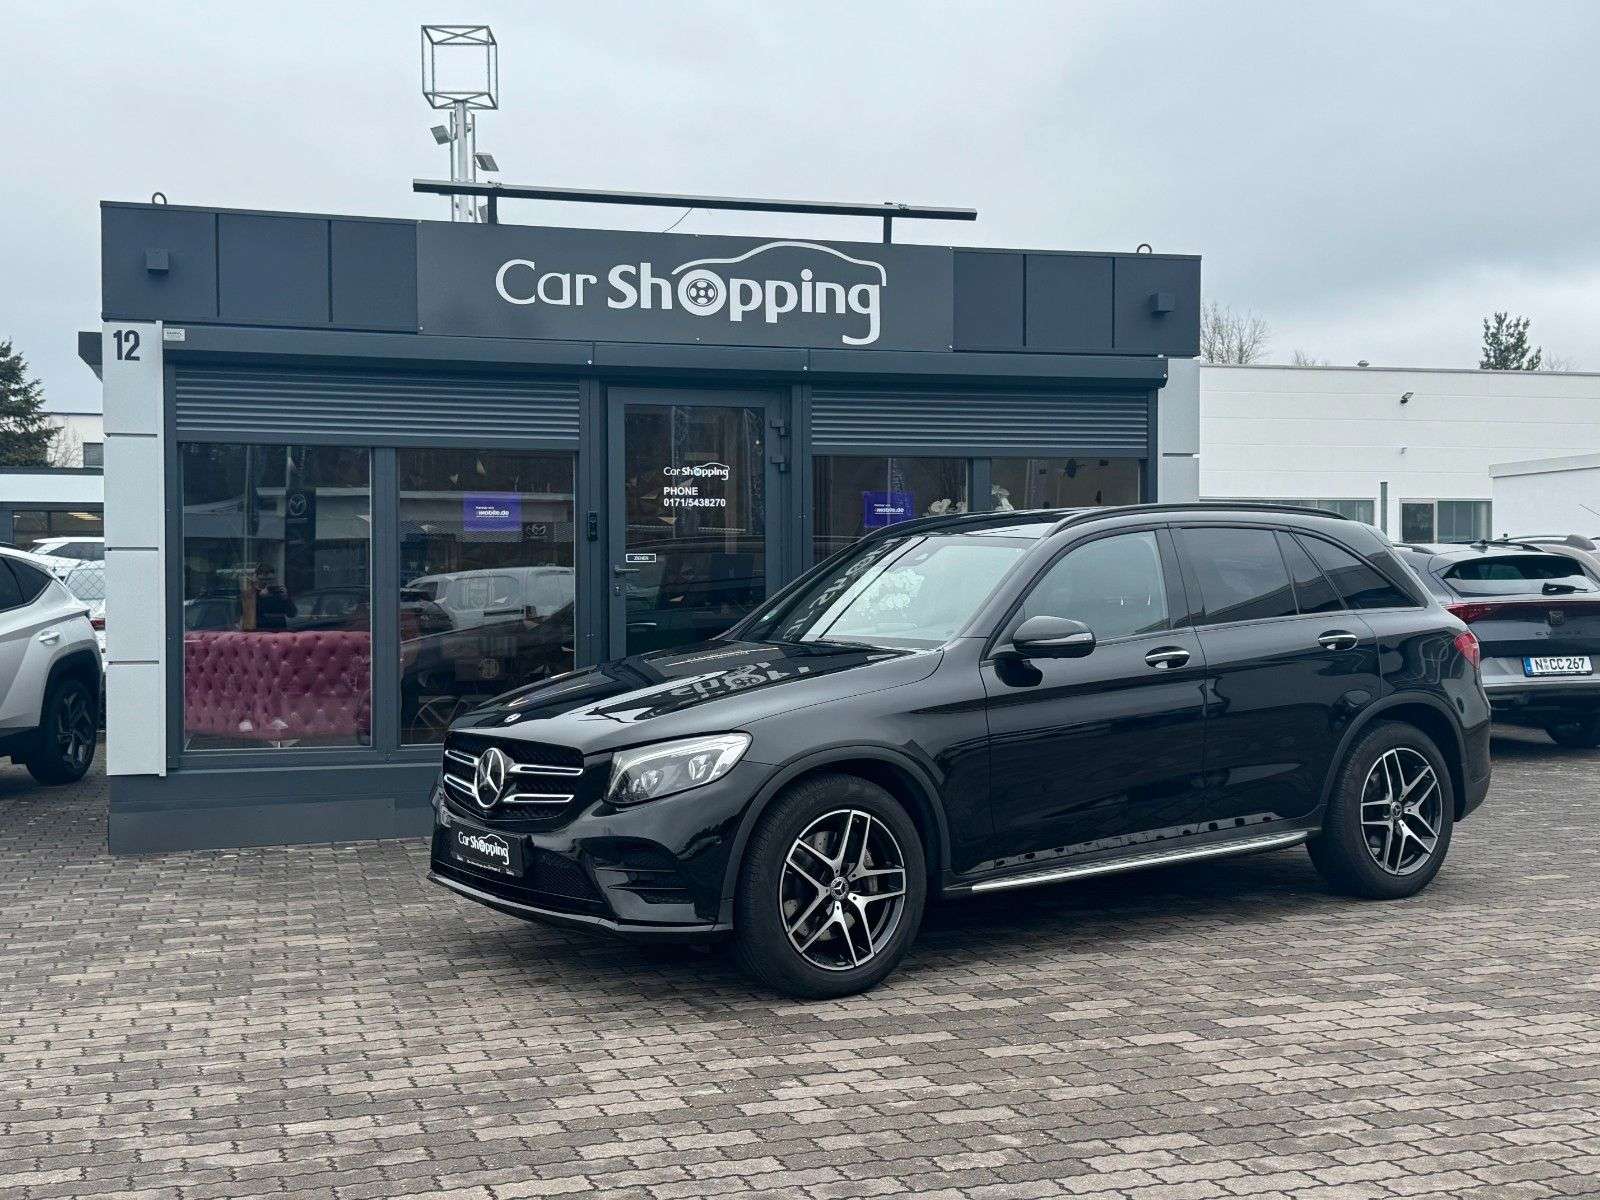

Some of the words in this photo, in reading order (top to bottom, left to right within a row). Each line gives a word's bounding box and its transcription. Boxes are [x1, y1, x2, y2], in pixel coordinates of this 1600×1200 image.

[495, 258, 598, 306] Car
[606, 261, 884, 346] Shopping
[113, 329, 140, 361] 12
[663, 466, 681, 476] Car
[681, 465, 730, 481] Shopping
[663, 486, 699, 496] PHONE
[663, 498, 726, 507] 0171/5438270
[1535, 659, 1544, 671] N
[1549, 658, 1565, 670] CC
[1566, 657, 1585, 670] 267
[458, 831, 470, 846] Car
[470, 834, 510, 865] Shopping
